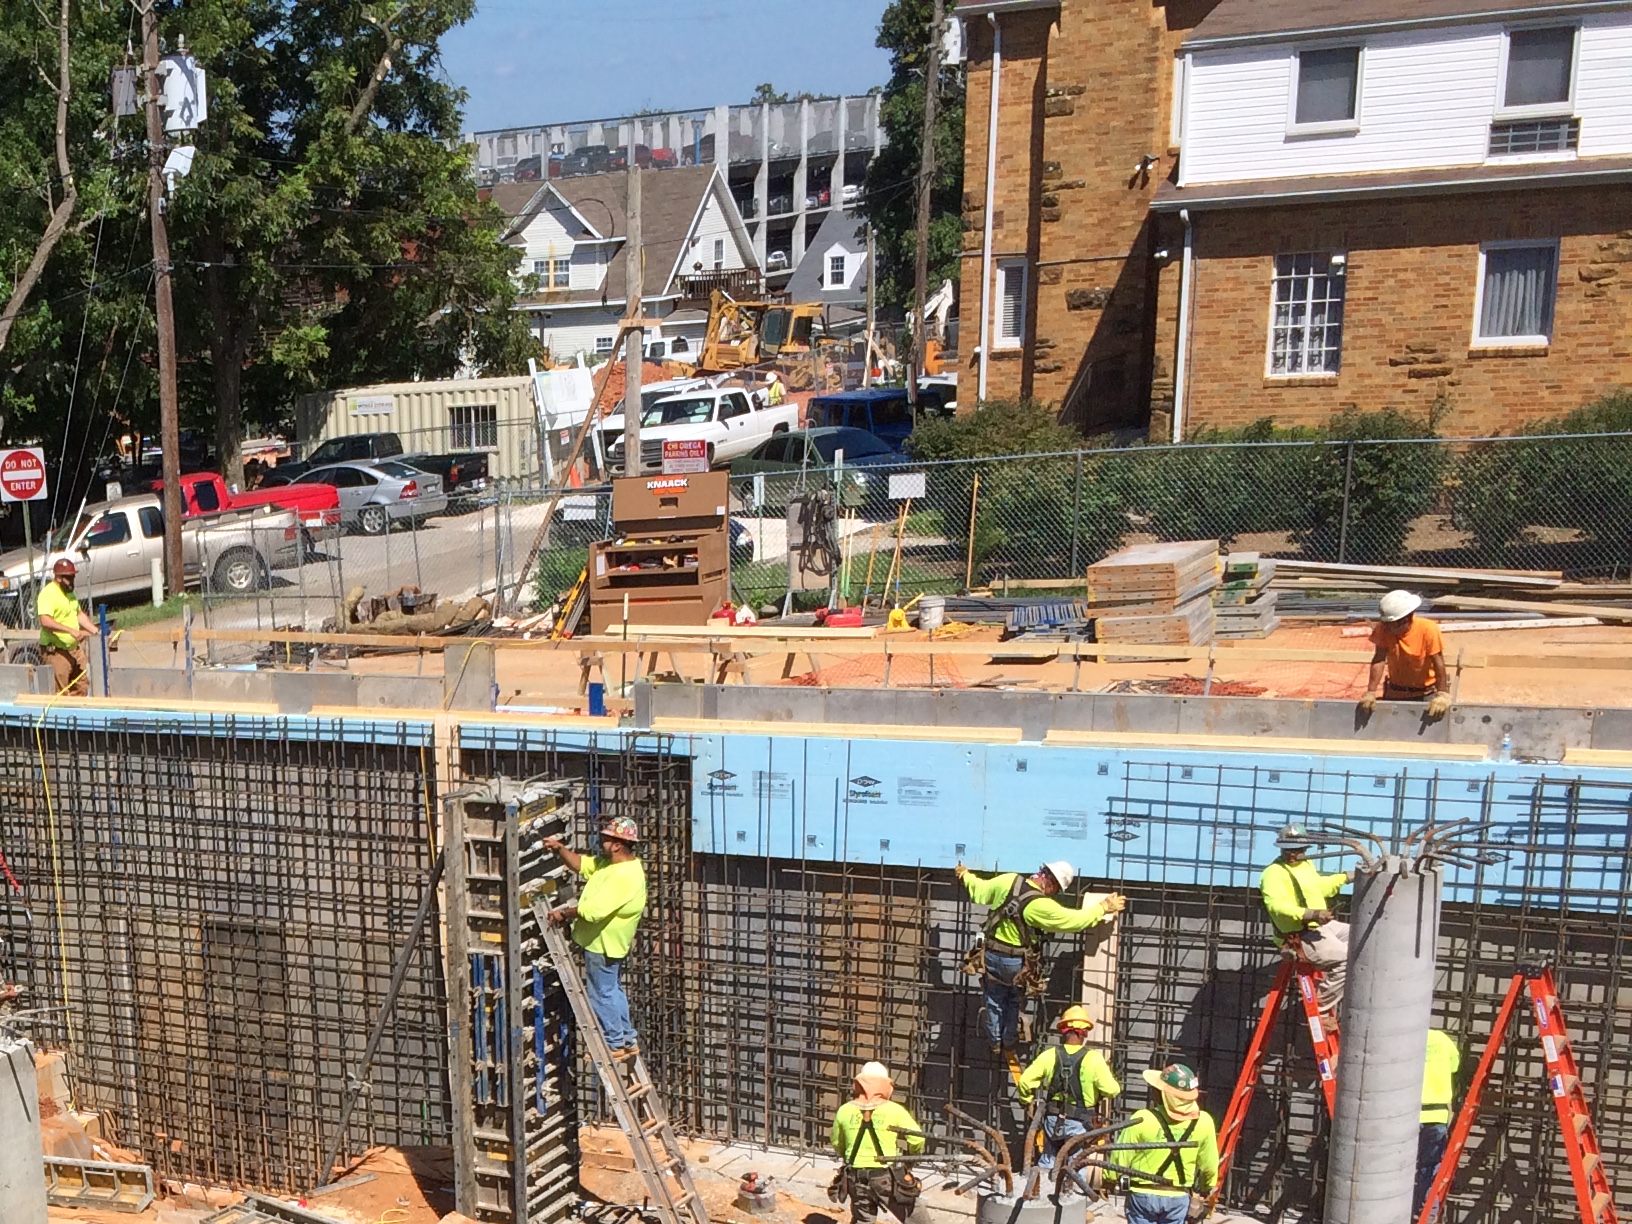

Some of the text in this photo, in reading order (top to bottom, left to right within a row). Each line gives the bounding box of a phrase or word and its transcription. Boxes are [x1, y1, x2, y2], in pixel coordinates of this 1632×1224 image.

[664, 449, 704, 458] PARKING ONLY
[5, 458, 37, 470] DO NOT
[10, 480, 37, 491] ENTER
[646, 478, 689, 490] KNAACK
